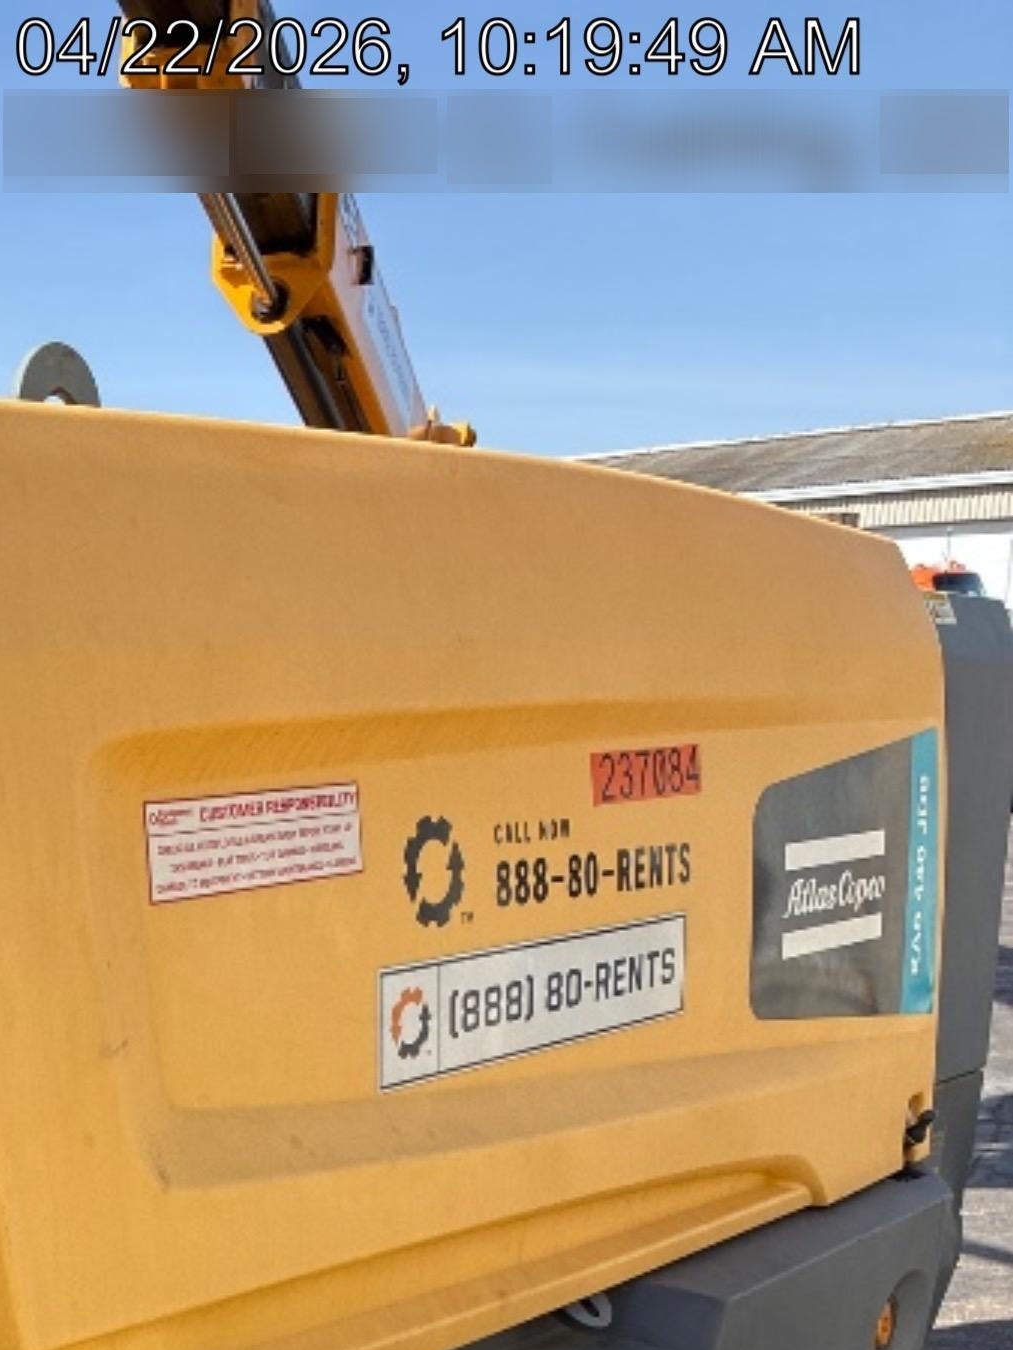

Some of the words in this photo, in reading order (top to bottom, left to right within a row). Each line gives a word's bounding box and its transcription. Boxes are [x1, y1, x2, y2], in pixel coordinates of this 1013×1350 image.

[600, 745, 700, 802] 237084
[496, 843, 691, 907] 888-80-RENTS
[783, 878, 836, 918] Atlas
[838, 869, 886, 912] Copco
[449, 974, 534, 1038] (888)
[546, 947, 676, 1012] 80-RENTS
